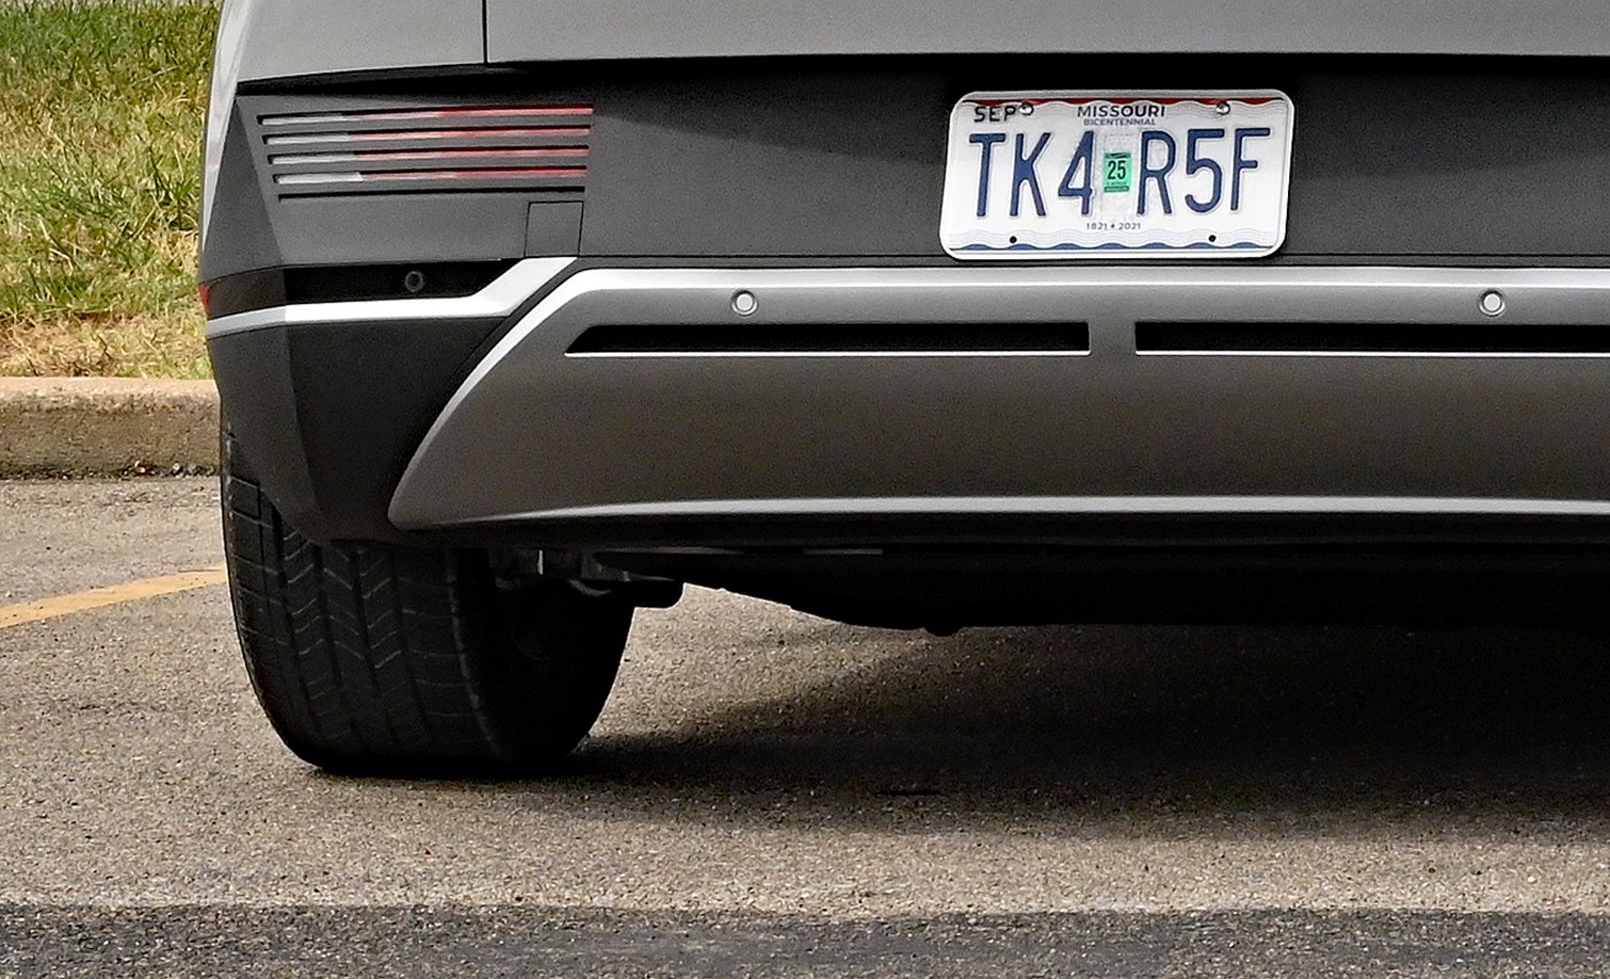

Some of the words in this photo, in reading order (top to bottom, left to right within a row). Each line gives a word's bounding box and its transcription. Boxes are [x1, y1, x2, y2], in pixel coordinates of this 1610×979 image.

[974, 105, 1017, 123] SEP
[1077, 105, 1165, 118] MISSOURI
[1084, 118, 1156, 127] BICENTENNIAL
[968, 130, 1095, 217] TK4
[1137, 127, 1271, 215] R5F
[1107, 160, 1127, 180] 25
